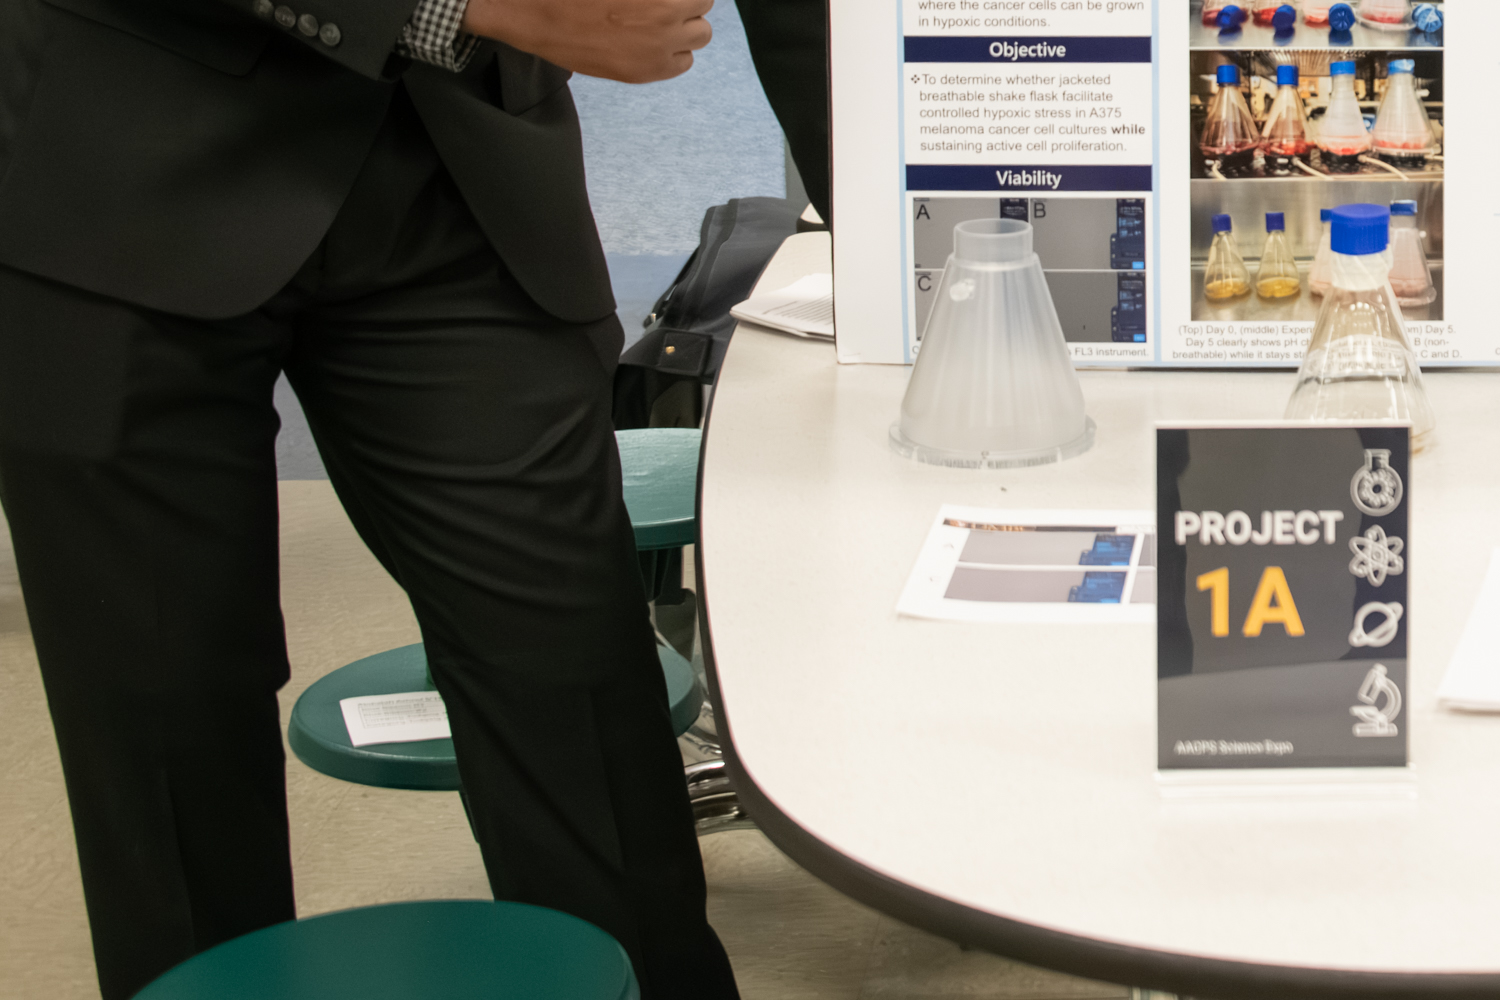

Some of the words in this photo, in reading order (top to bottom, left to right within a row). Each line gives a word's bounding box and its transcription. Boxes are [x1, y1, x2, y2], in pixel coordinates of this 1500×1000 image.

[988, 41, 1067, 61] Objective
[995, 169, 1063, 190] Viability
[916, 204, 930, 220] A
[1033, 202, 1046, 219] B
[917, 276, 932, 292] C
[1075, 348, 1092, 356] FL3
[1096, 348, 1149, 357] instrument.
[1175, 510, 1344, 545] PROJECT
[1196, 566, 1306, 637] 1A
[1174, 740, 1218, 755] AACPS
[1220, 740, 1263, 755] Science
[1265, 739, 1294, 757] Expo
